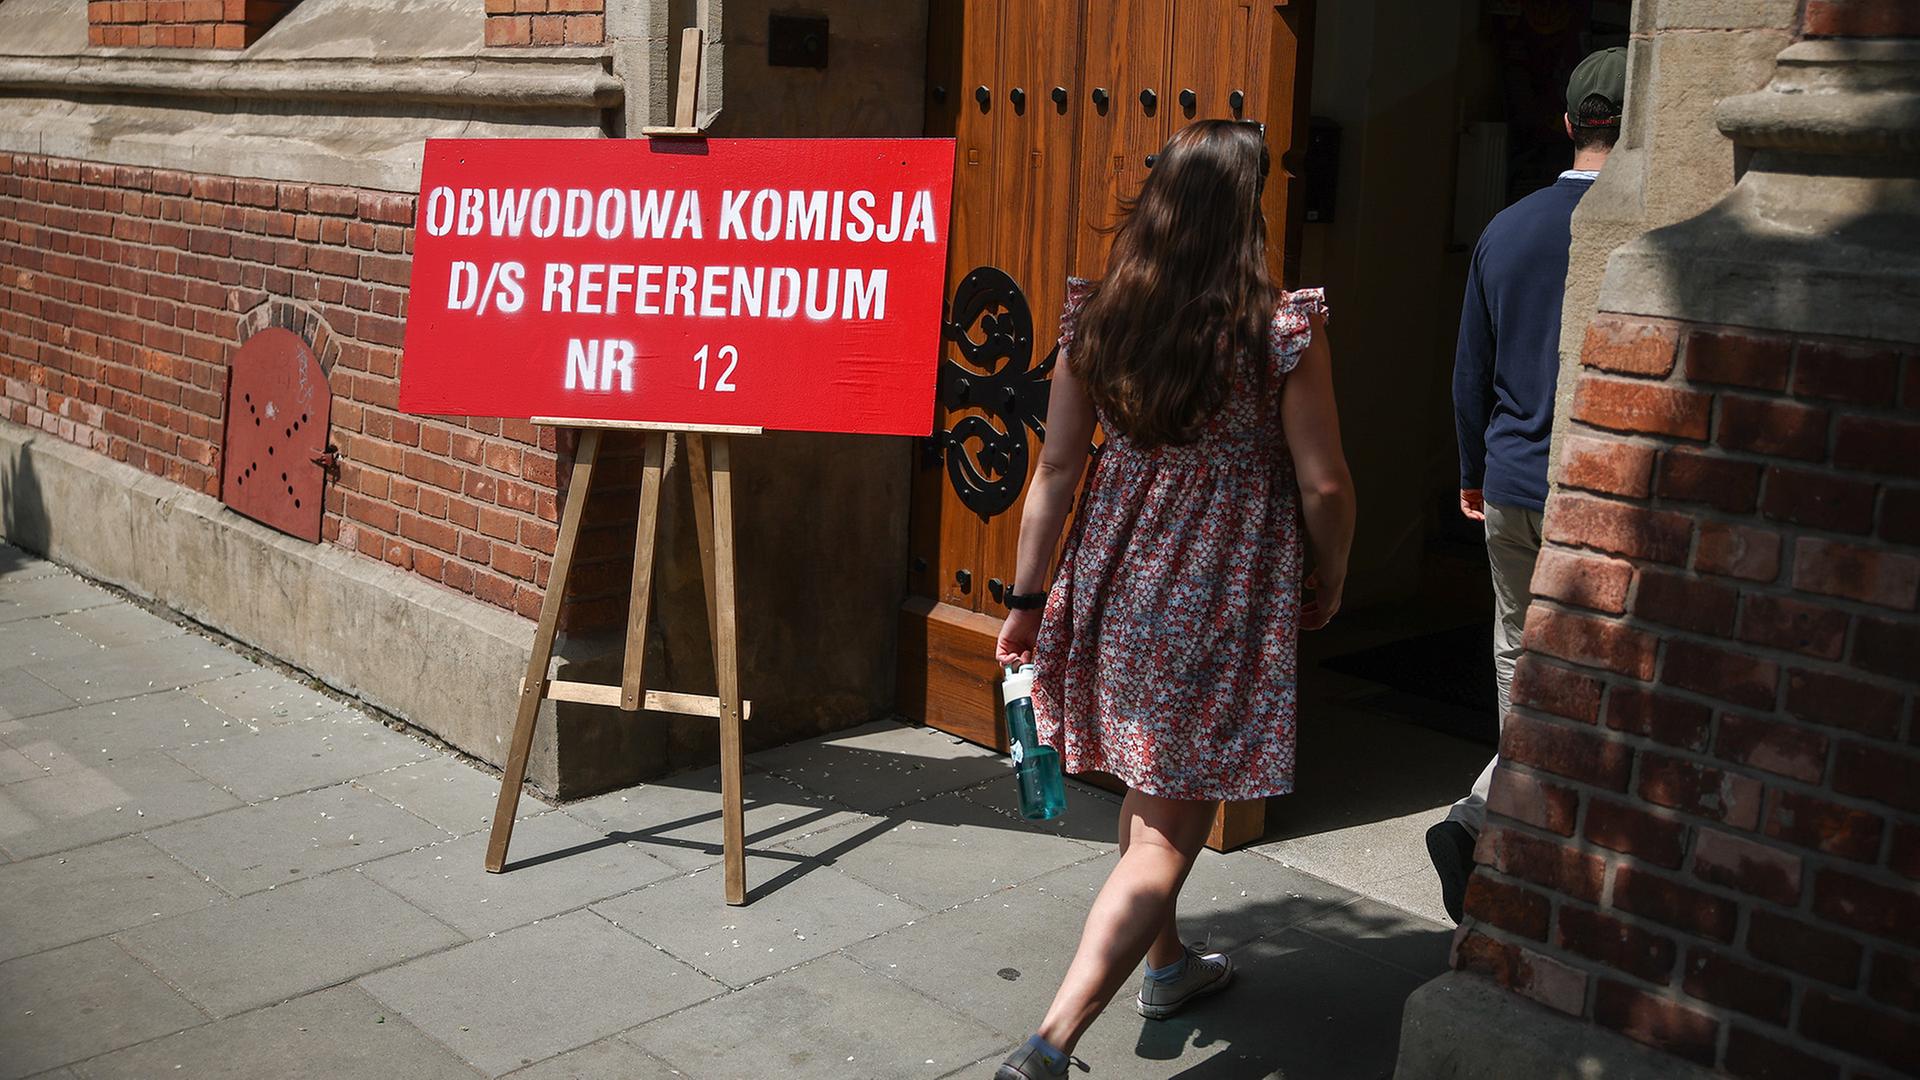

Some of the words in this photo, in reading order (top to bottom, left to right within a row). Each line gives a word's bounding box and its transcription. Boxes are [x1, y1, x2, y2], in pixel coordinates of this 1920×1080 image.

[426, 186, 703, 240] OBWODOWA
[719, 189, 936, 243] KOMISJA
[447, 261, 525, 316] D/S
[542, 263, 887, 321] REFERENDUM
[564, 338, 636, 392] NR
[694, 345, 738, 391] 12
